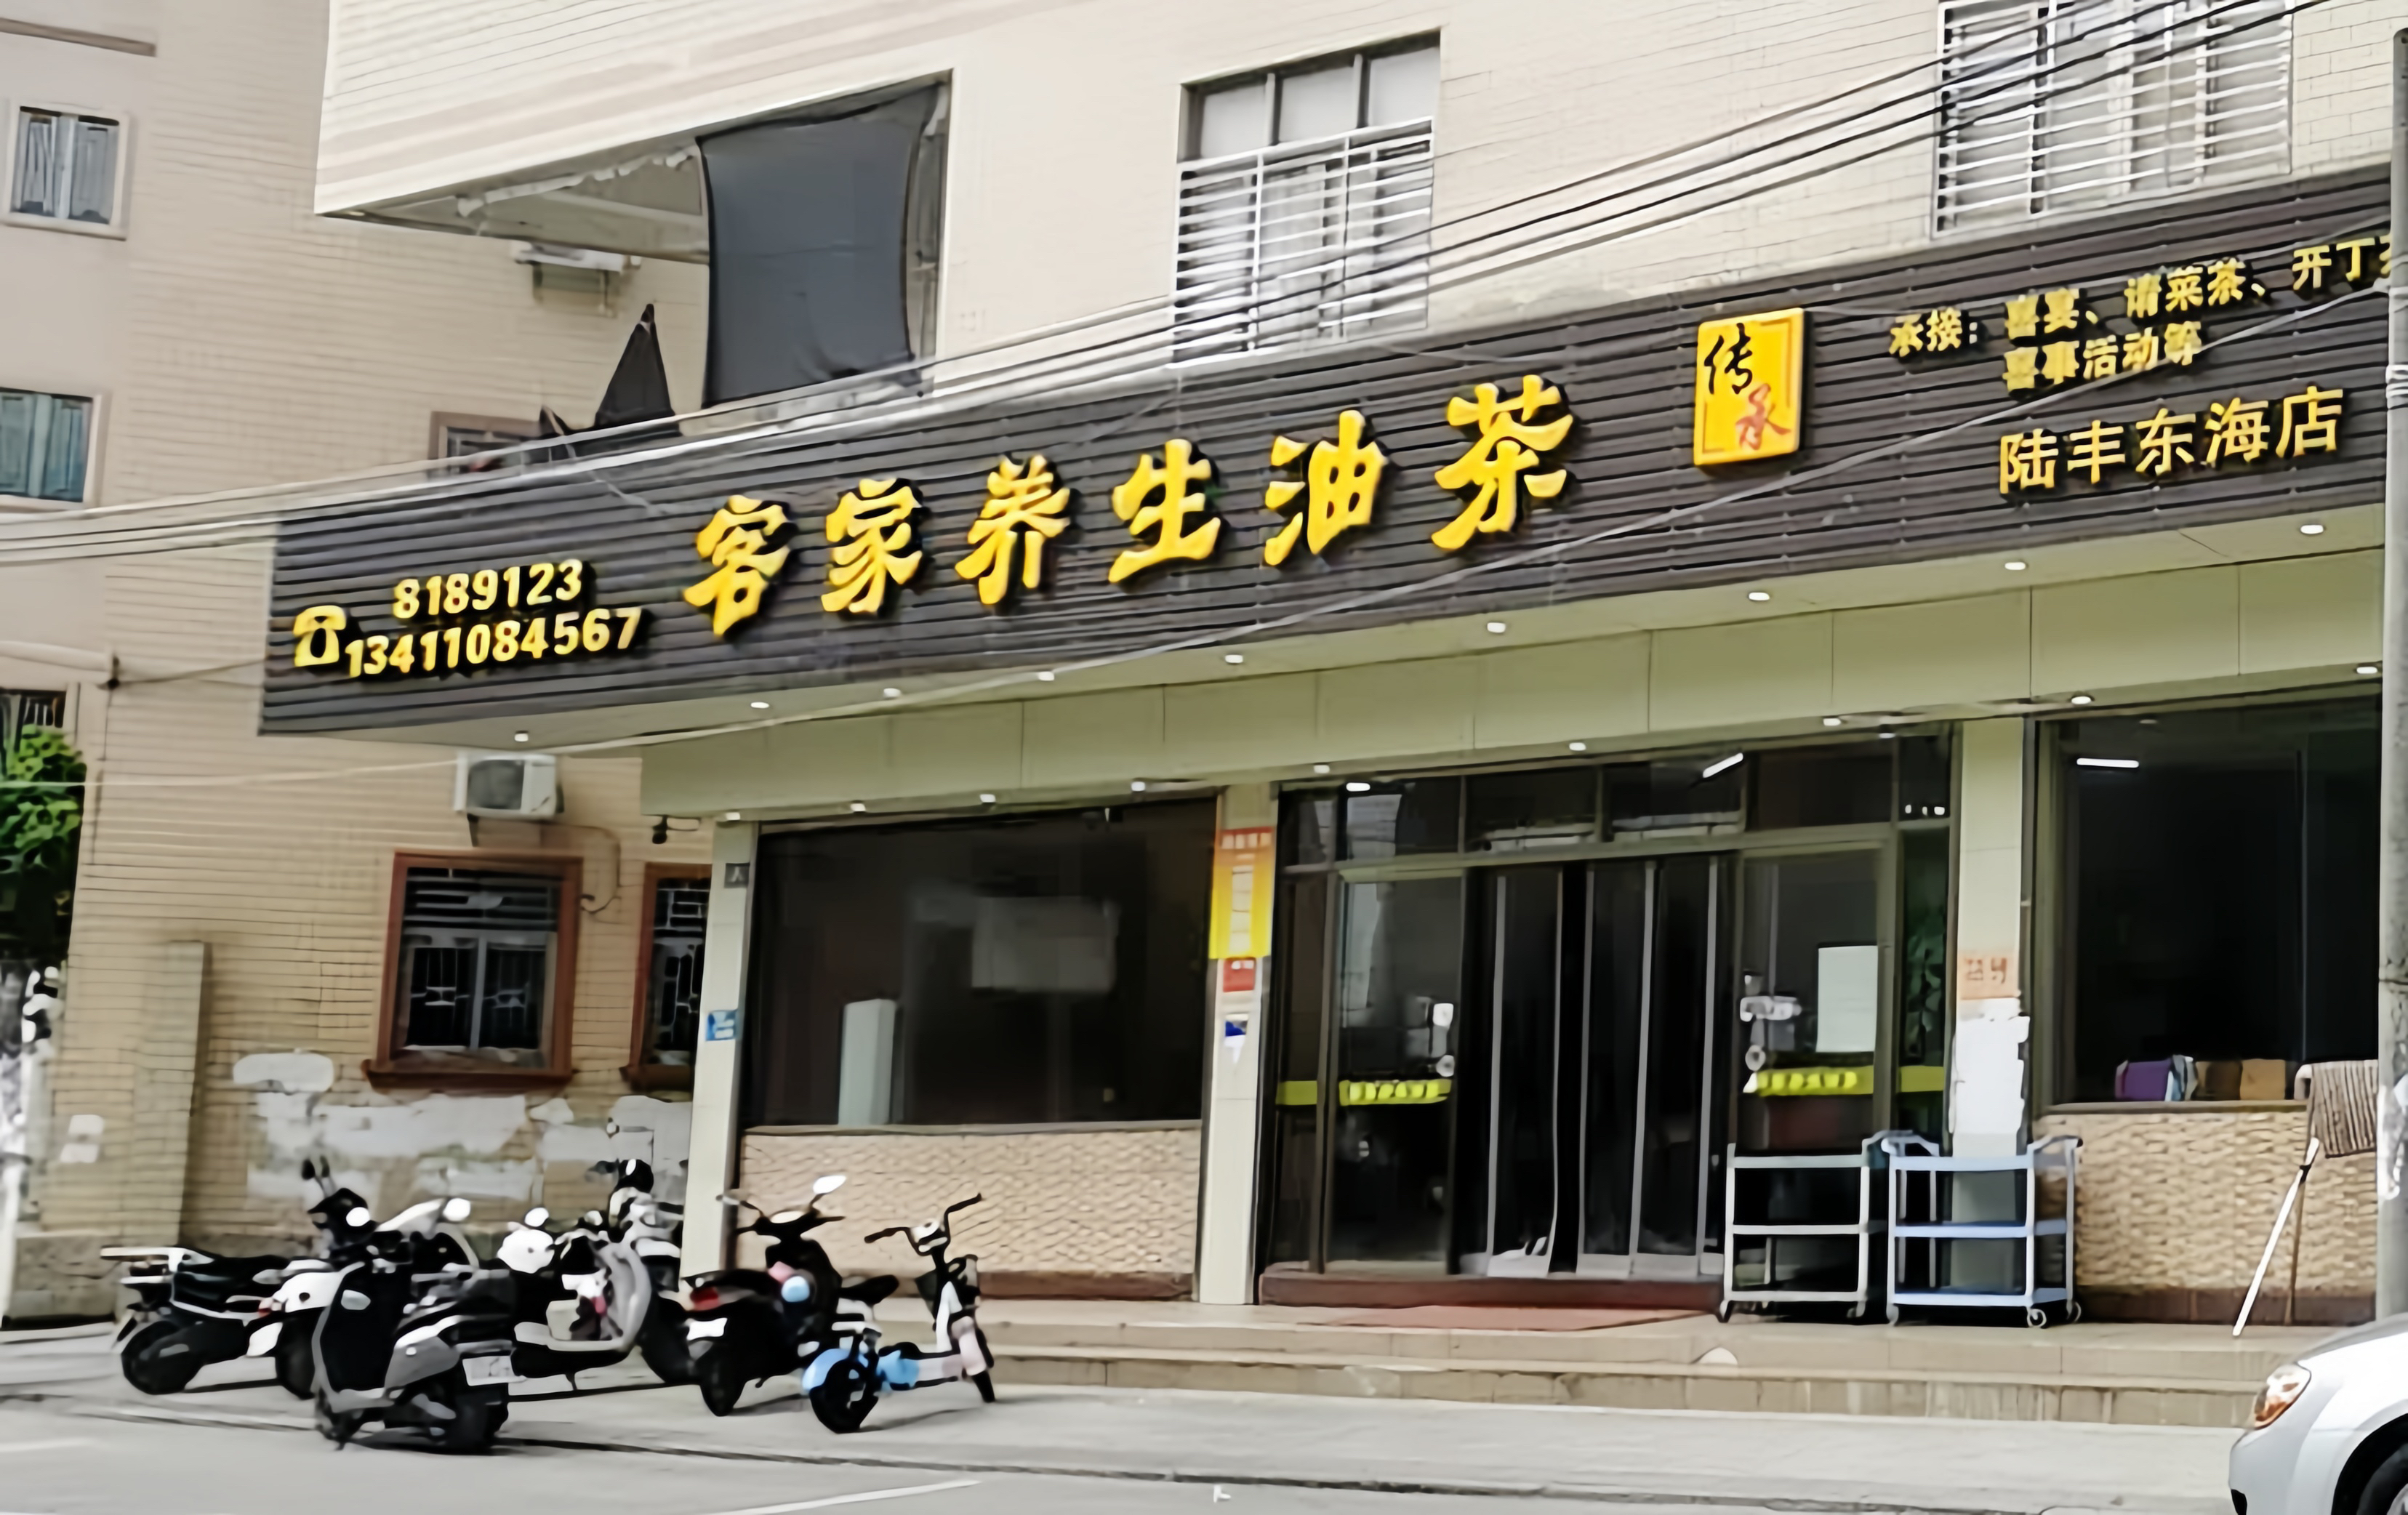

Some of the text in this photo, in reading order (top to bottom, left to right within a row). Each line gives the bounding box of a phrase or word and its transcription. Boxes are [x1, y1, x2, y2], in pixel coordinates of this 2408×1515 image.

[1999, 385, 2343, 494] 陆丰东海店
[683, 374, 1573, 636] 客家养生油茶
[393, 559, 582, 619] 8189123
[345, 606, 642, 678] 13411084567
